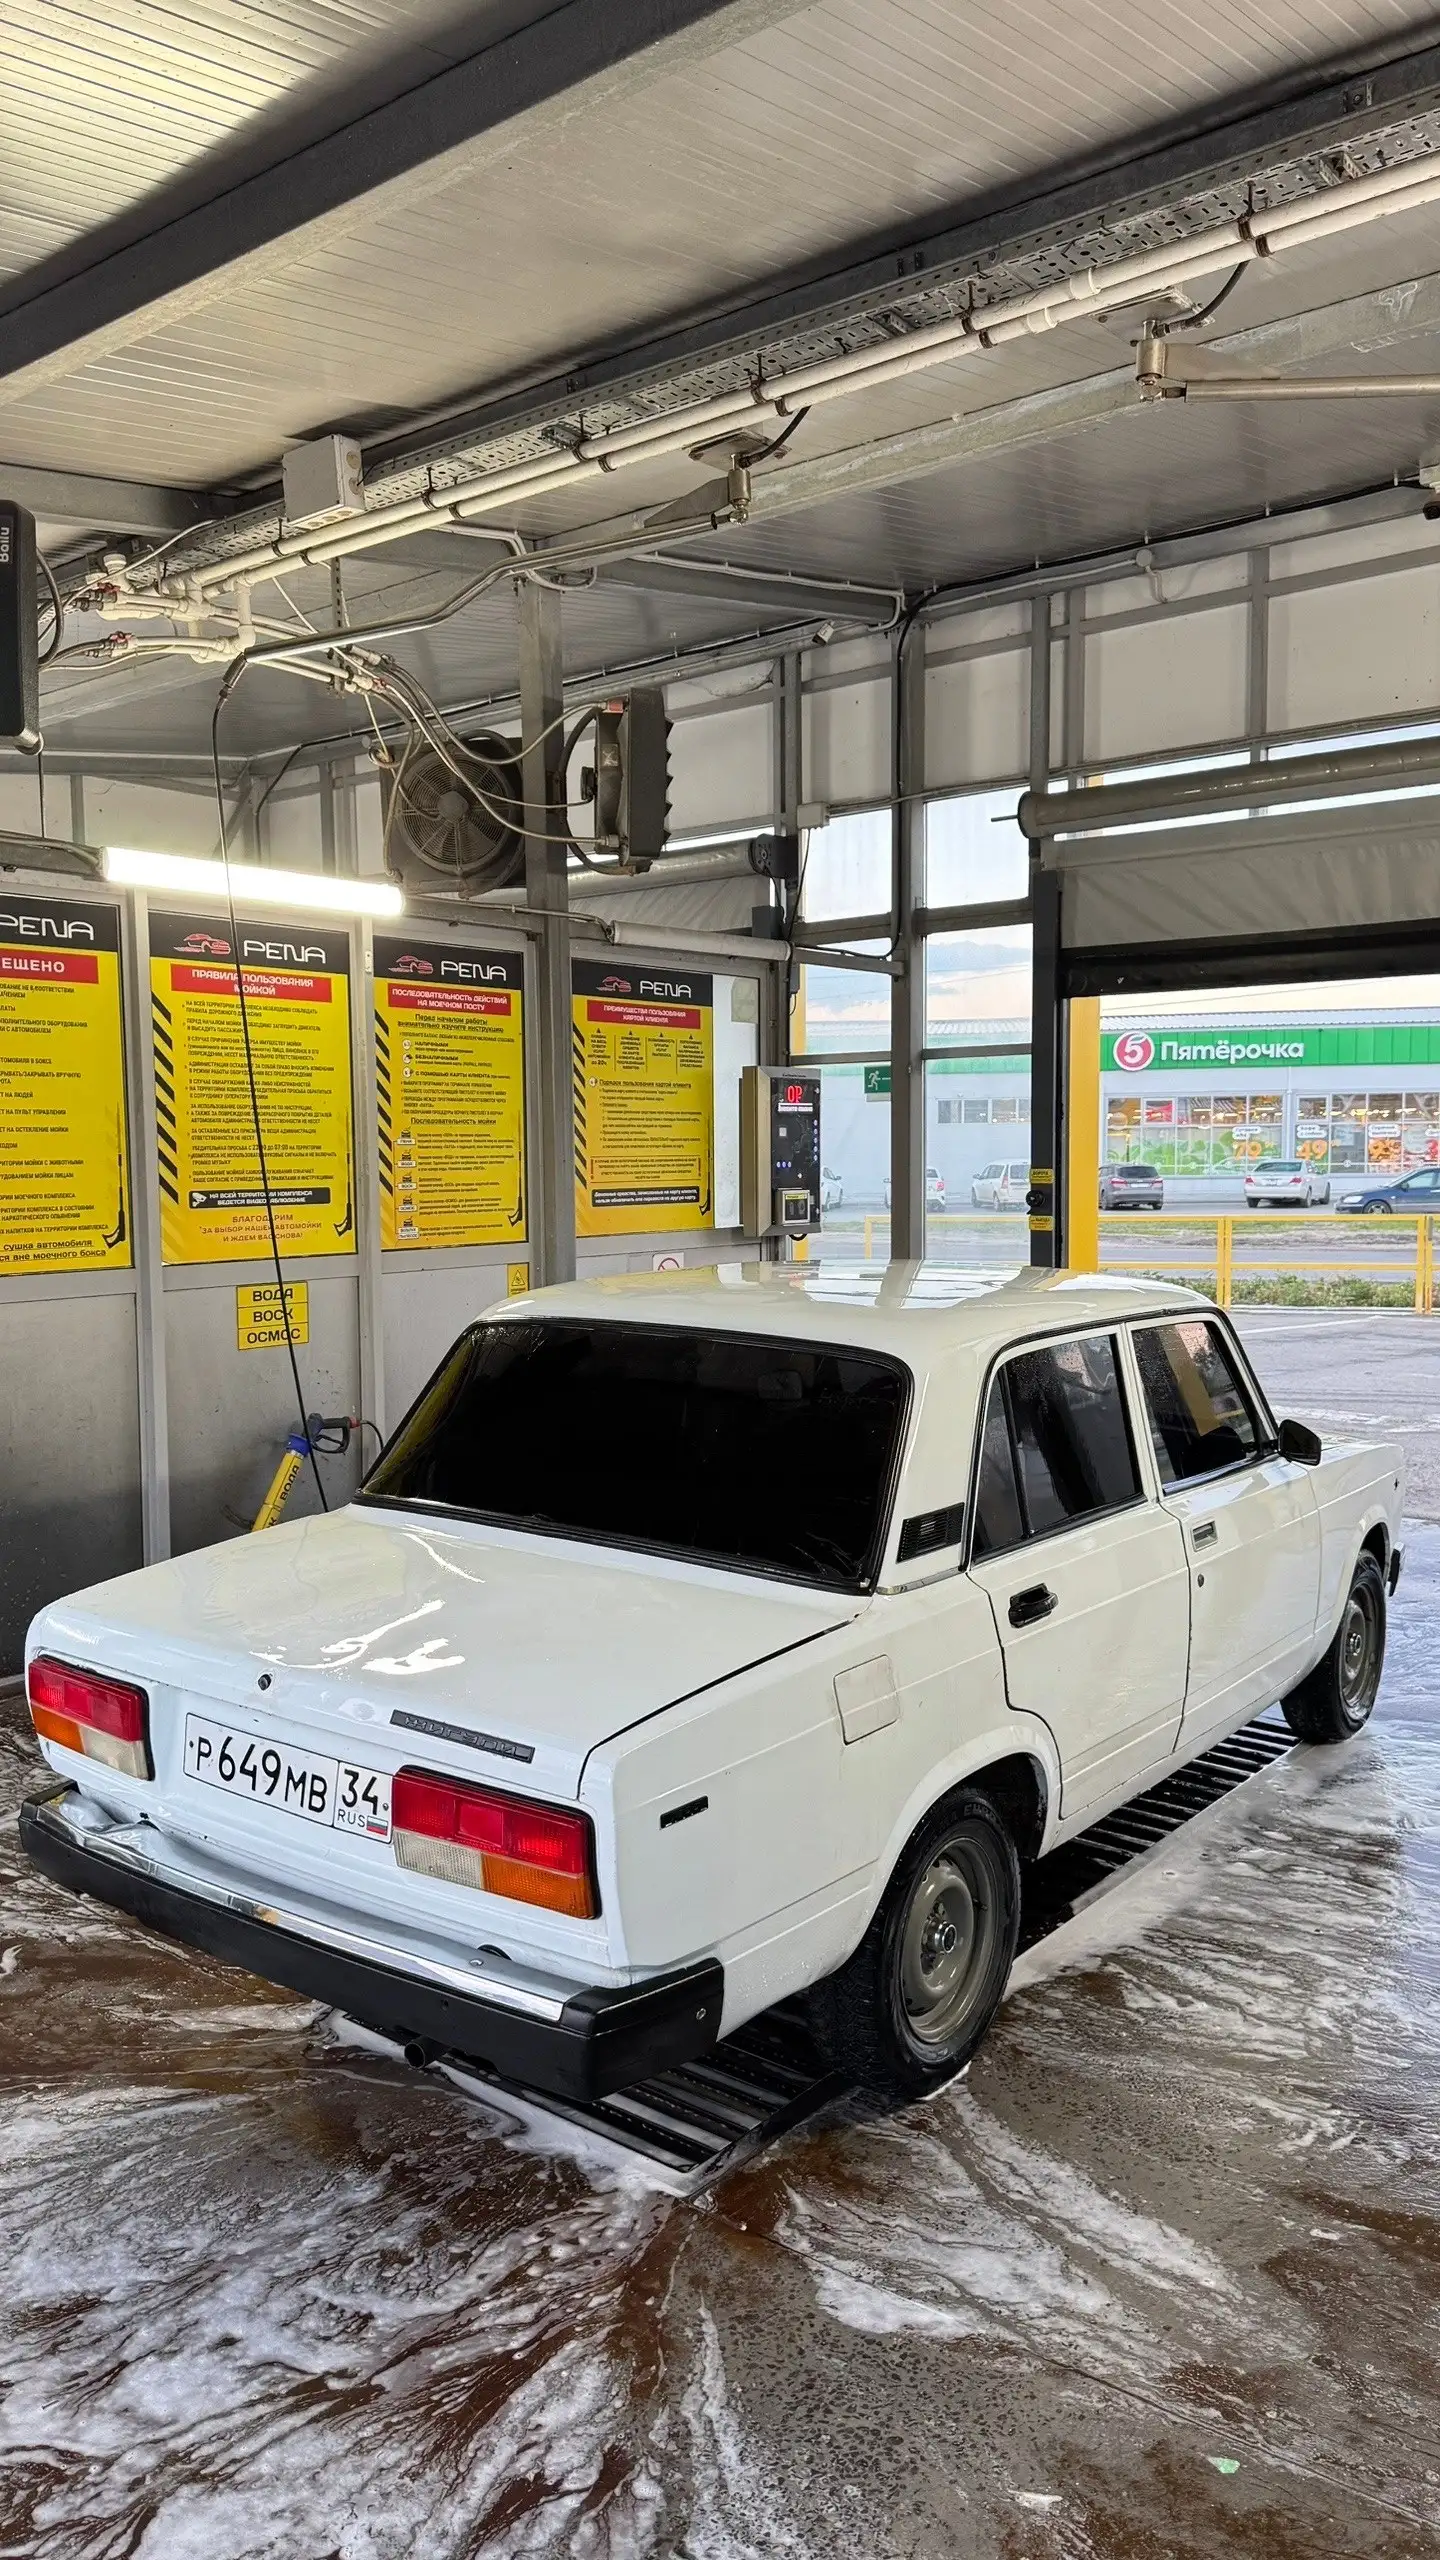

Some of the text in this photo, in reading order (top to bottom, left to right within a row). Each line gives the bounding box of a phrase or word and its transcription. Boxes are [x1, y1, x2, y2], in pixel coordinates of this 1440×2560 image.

[243, 939, 327, 964] PENA
[440, 960, 507, 982] PENA
[242, 974, 314, 987] ПОЛЬЗОВАНИЯ
[391, 988, 508, 1005] ПОСЛЕДОВАТЕЛЬНОСТЬ ДЕЙСТВИЙ
[639, 980, 692, 999] PENA
[429, 1000, 462, 1009] МОЕЧНОМ
[463, 1003, 485, 1011] ПОСТУ
[415, 1014, 488, 1027] Перед началом работы
[1160, 1039, 1305, 1065] Пятёрочка
[411, 1117, 476, 1125] Последовательность
[232, 1214, 294, 1223] БЛАГОДРИМ
[275, 1222, 322, 1231] АВТОМОЙКИ
[4, 1239, 92, 1251] сушка автомобиля
[33, 1252, 78, 1260] моечного
[80, 1249, 107, 1257] бокса
[252, 1288, 293, 1302] ВОДА
[253, 1309, 294, 1323] ВОСК
[247, 1328, 301, 1344] ОСМОС
[280, 1463, 300, 1502] ВОДА
[195, 1736, 379, 1816] Р649МВ 34
[337, 1810, 366, 1828] RUS
